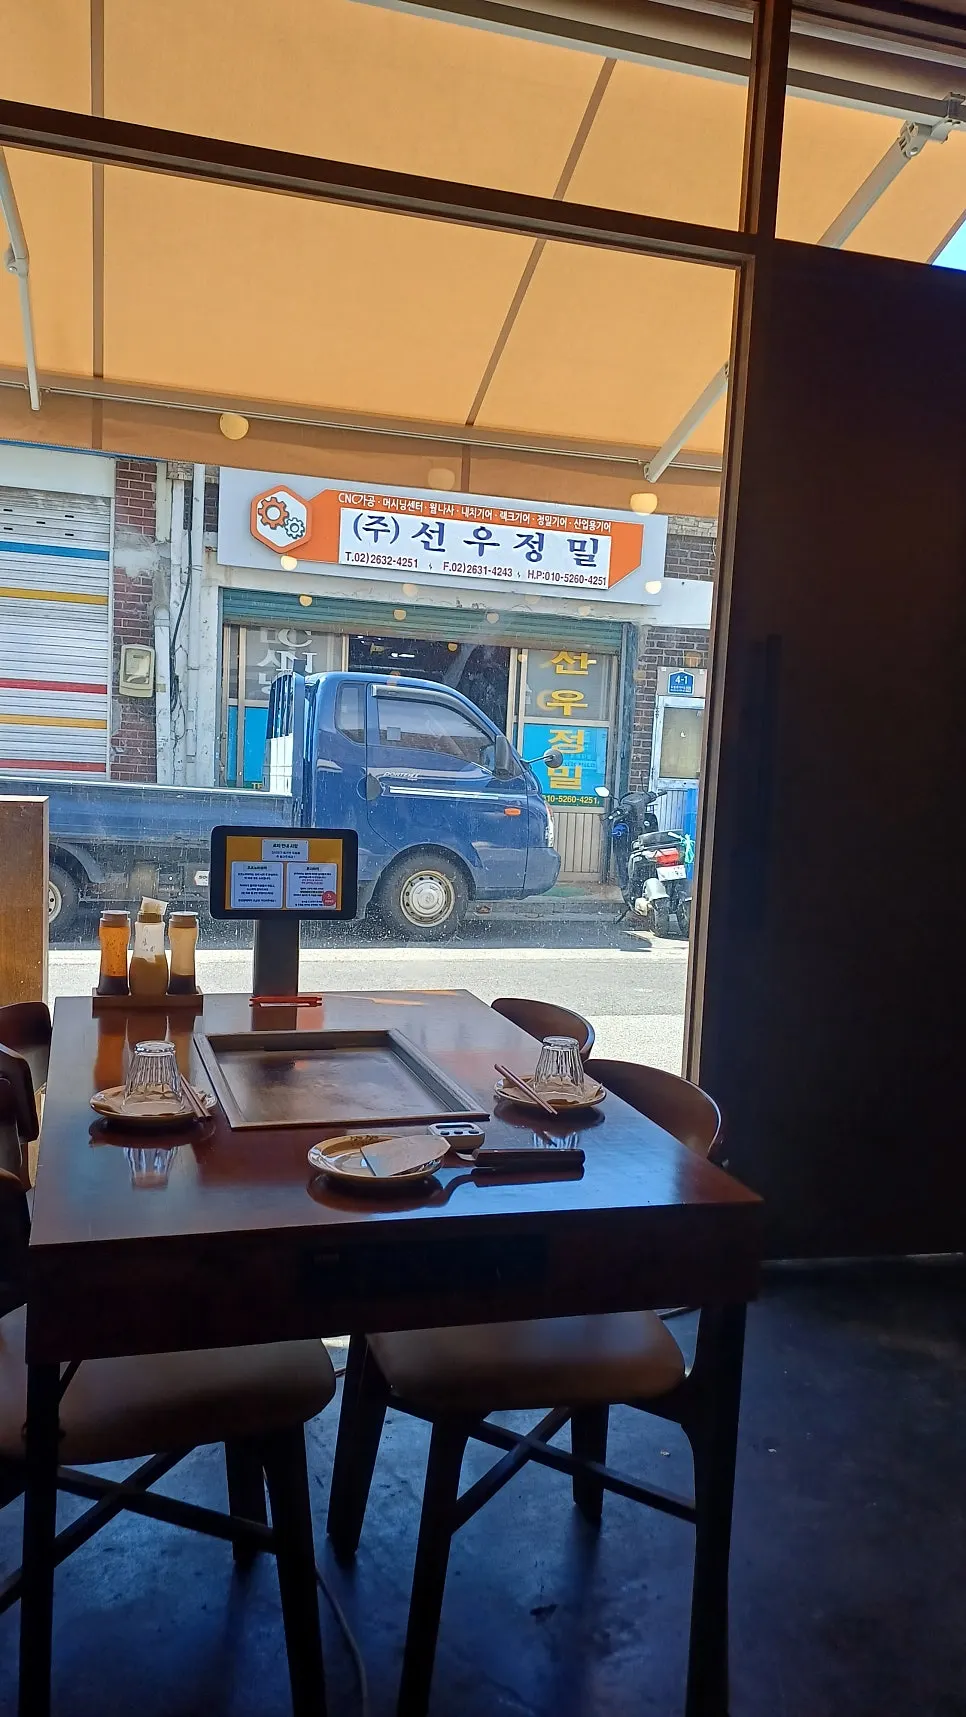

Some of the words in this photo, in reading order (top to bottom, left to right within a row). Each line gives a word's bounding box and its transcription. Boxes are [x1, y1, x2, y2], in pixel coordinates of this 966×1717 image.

[338, 493, 376, 507] CNC가공
[382, 497, 424, 512] 머시닝센터
[461, 506, 493, 520] 내치기어
[537, 514, 568, 528] 정밀기어
[574, 518, 612, 533] 산업용기어
[353, 513, 400, 544] (주)
[345, 551, 418, 568] T.02)2632-4251
[443, 561, 513, 577] F.02)2631-4243
[527, 570, 607, 586] H.P:010-5260-4251
[675, 675, 688, 685] 4-1
